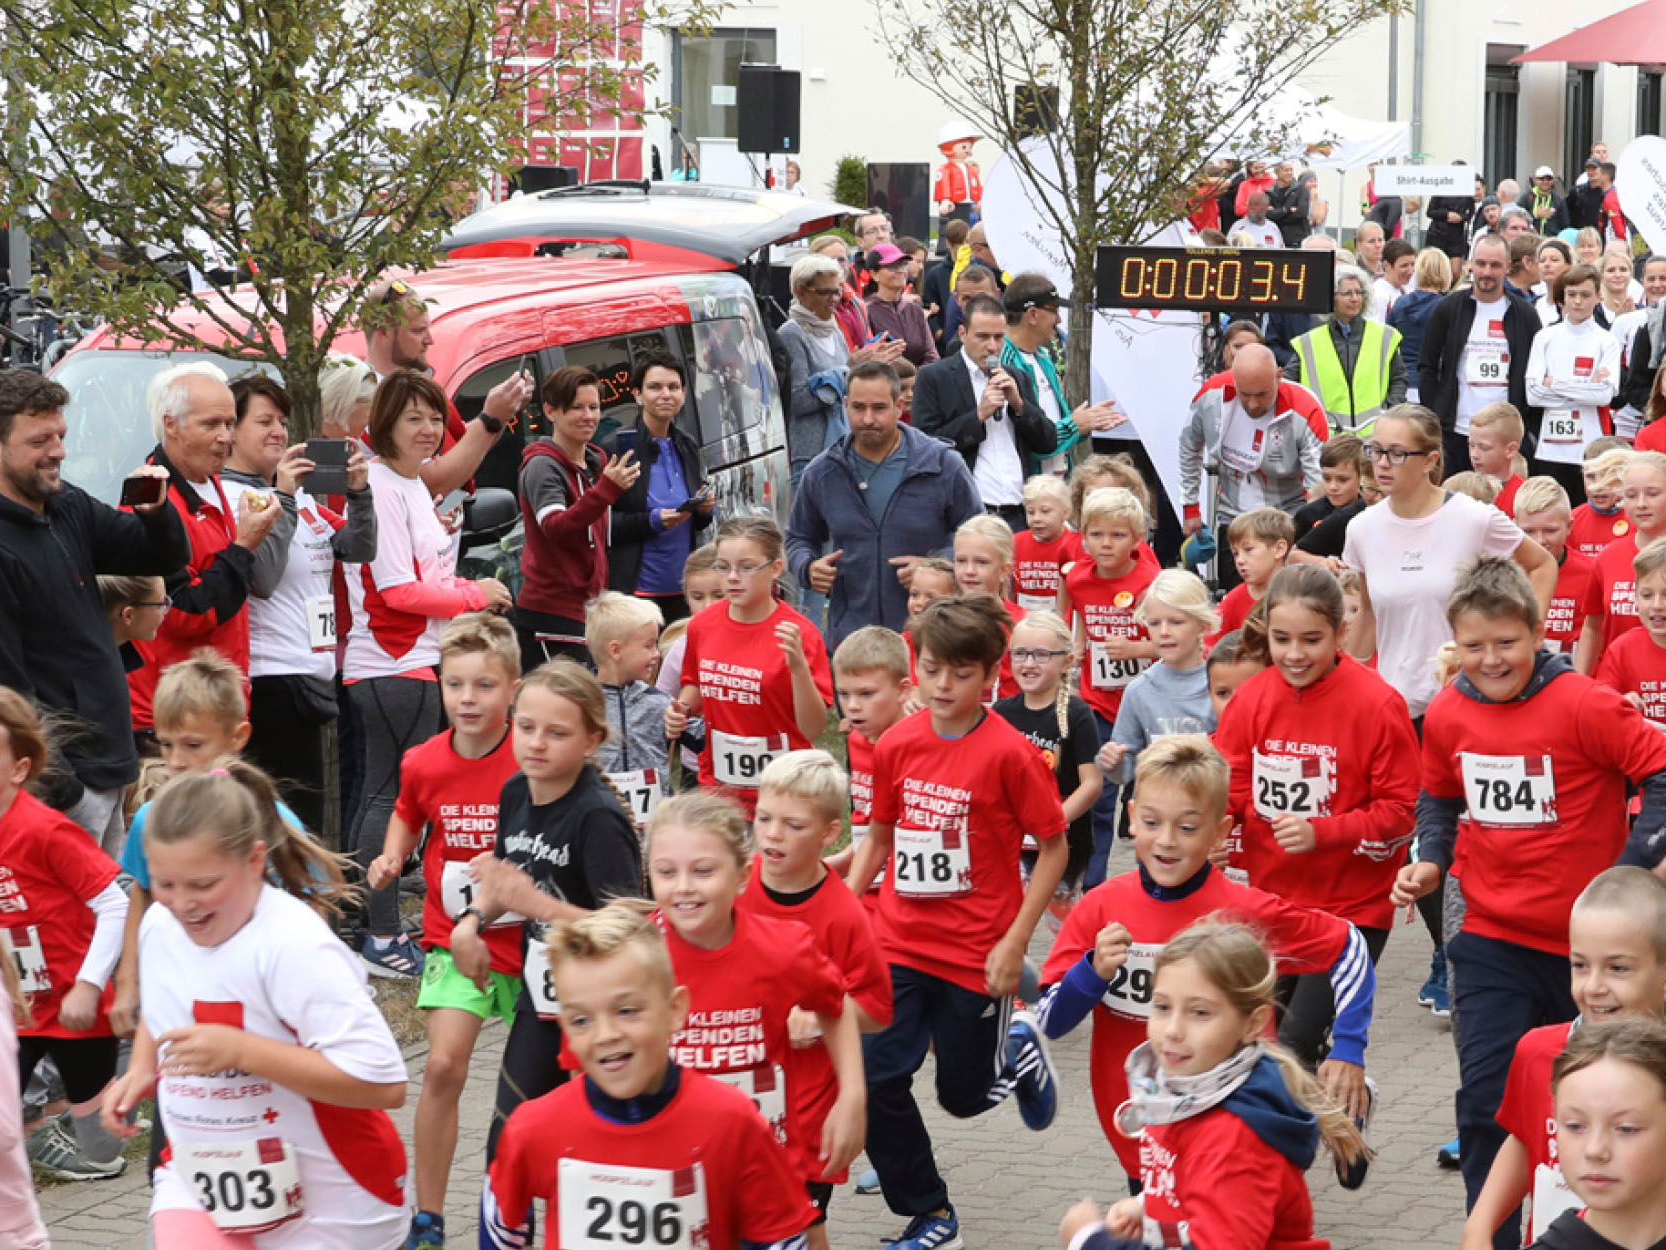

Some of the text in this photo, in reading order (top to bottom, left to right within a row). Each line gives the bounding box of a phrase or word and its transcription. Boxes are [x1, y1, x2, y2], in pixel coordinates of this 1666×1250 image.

[1121, 256, 1306, 303] 0:00:03.4
[1479, 362, 1499, 377] 99
[1549, 421, 1575, 434] 163
[1035, 561, 1059, 570] KLEIN
[1610, 602, 1640, 616] HEL
[1097, 657, 1140, 680] 130
[1285, 741, 1337, 758] KLEINEN
[1258, 776, 1311, 812] 252
[1474, 778, 1536, 811] 784
[440, 804, 500, 816] DIE KLEIN
[443, 818, 496, 832] SPEND
[444, 832, 497, 849] HELF
[896, 851, 952, 882] 218
[1110, 966, 1153, 1002] 29
[688, 1006, 763, 1027] KLEINEN
[670, 1023, 765, 1046] PENDEN
[194, 1168, 276, 1213] 303
[586, 1195, 683, 1246] 296
